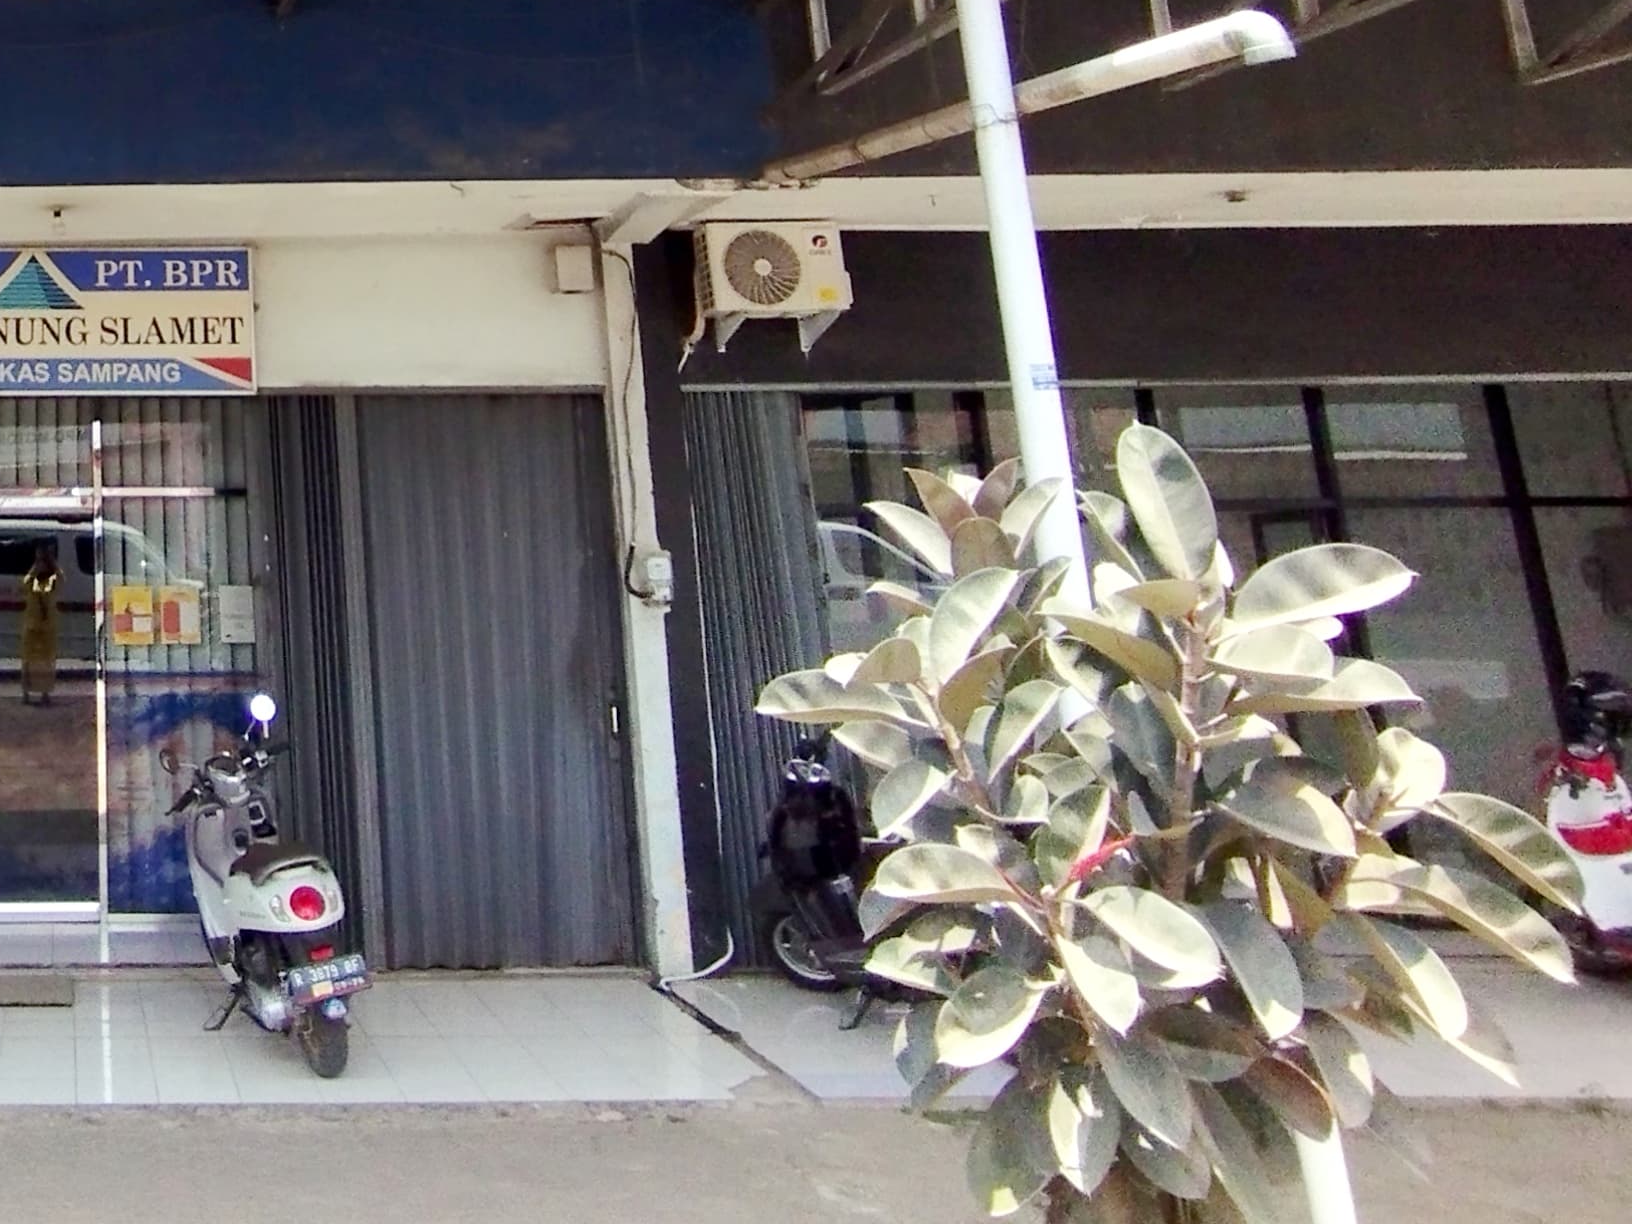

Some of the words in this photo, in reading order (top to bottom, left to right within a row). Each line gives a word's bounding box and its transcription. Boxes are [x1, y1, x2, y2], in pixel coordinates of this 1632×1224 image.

[94, 259, 152, 288] PT.
[162, 259, 241, 287] BPR
[99, 316, 245, 346] SLAMET
[0, 362, 50, 384] KAS
[57, 362, 181, 385] SAMPANG
[294, 972, 304, 987] R
